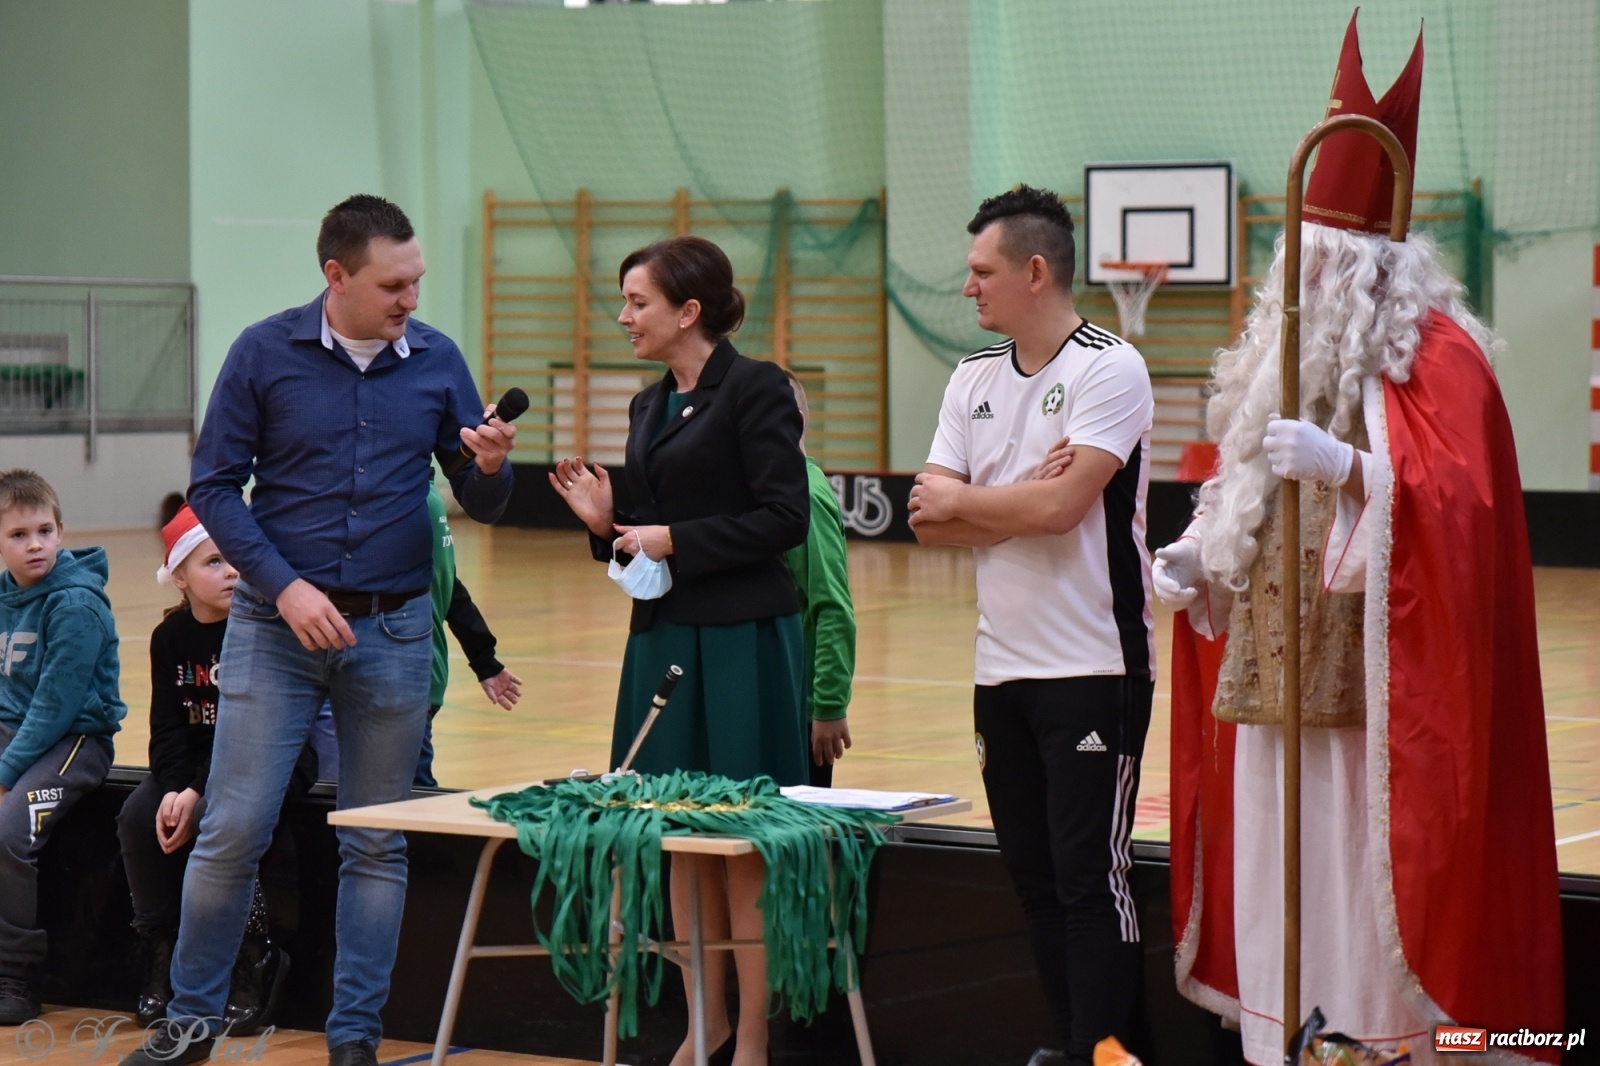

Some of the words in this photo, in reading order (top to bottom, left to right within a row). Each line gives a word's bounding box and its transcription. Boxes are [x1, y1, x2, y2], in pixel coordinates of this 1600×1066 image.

[971, 411, 994, 420] adidas
[1076, 743, 1107, 752] adidas
[27, 787, 64, 803] FIRST
